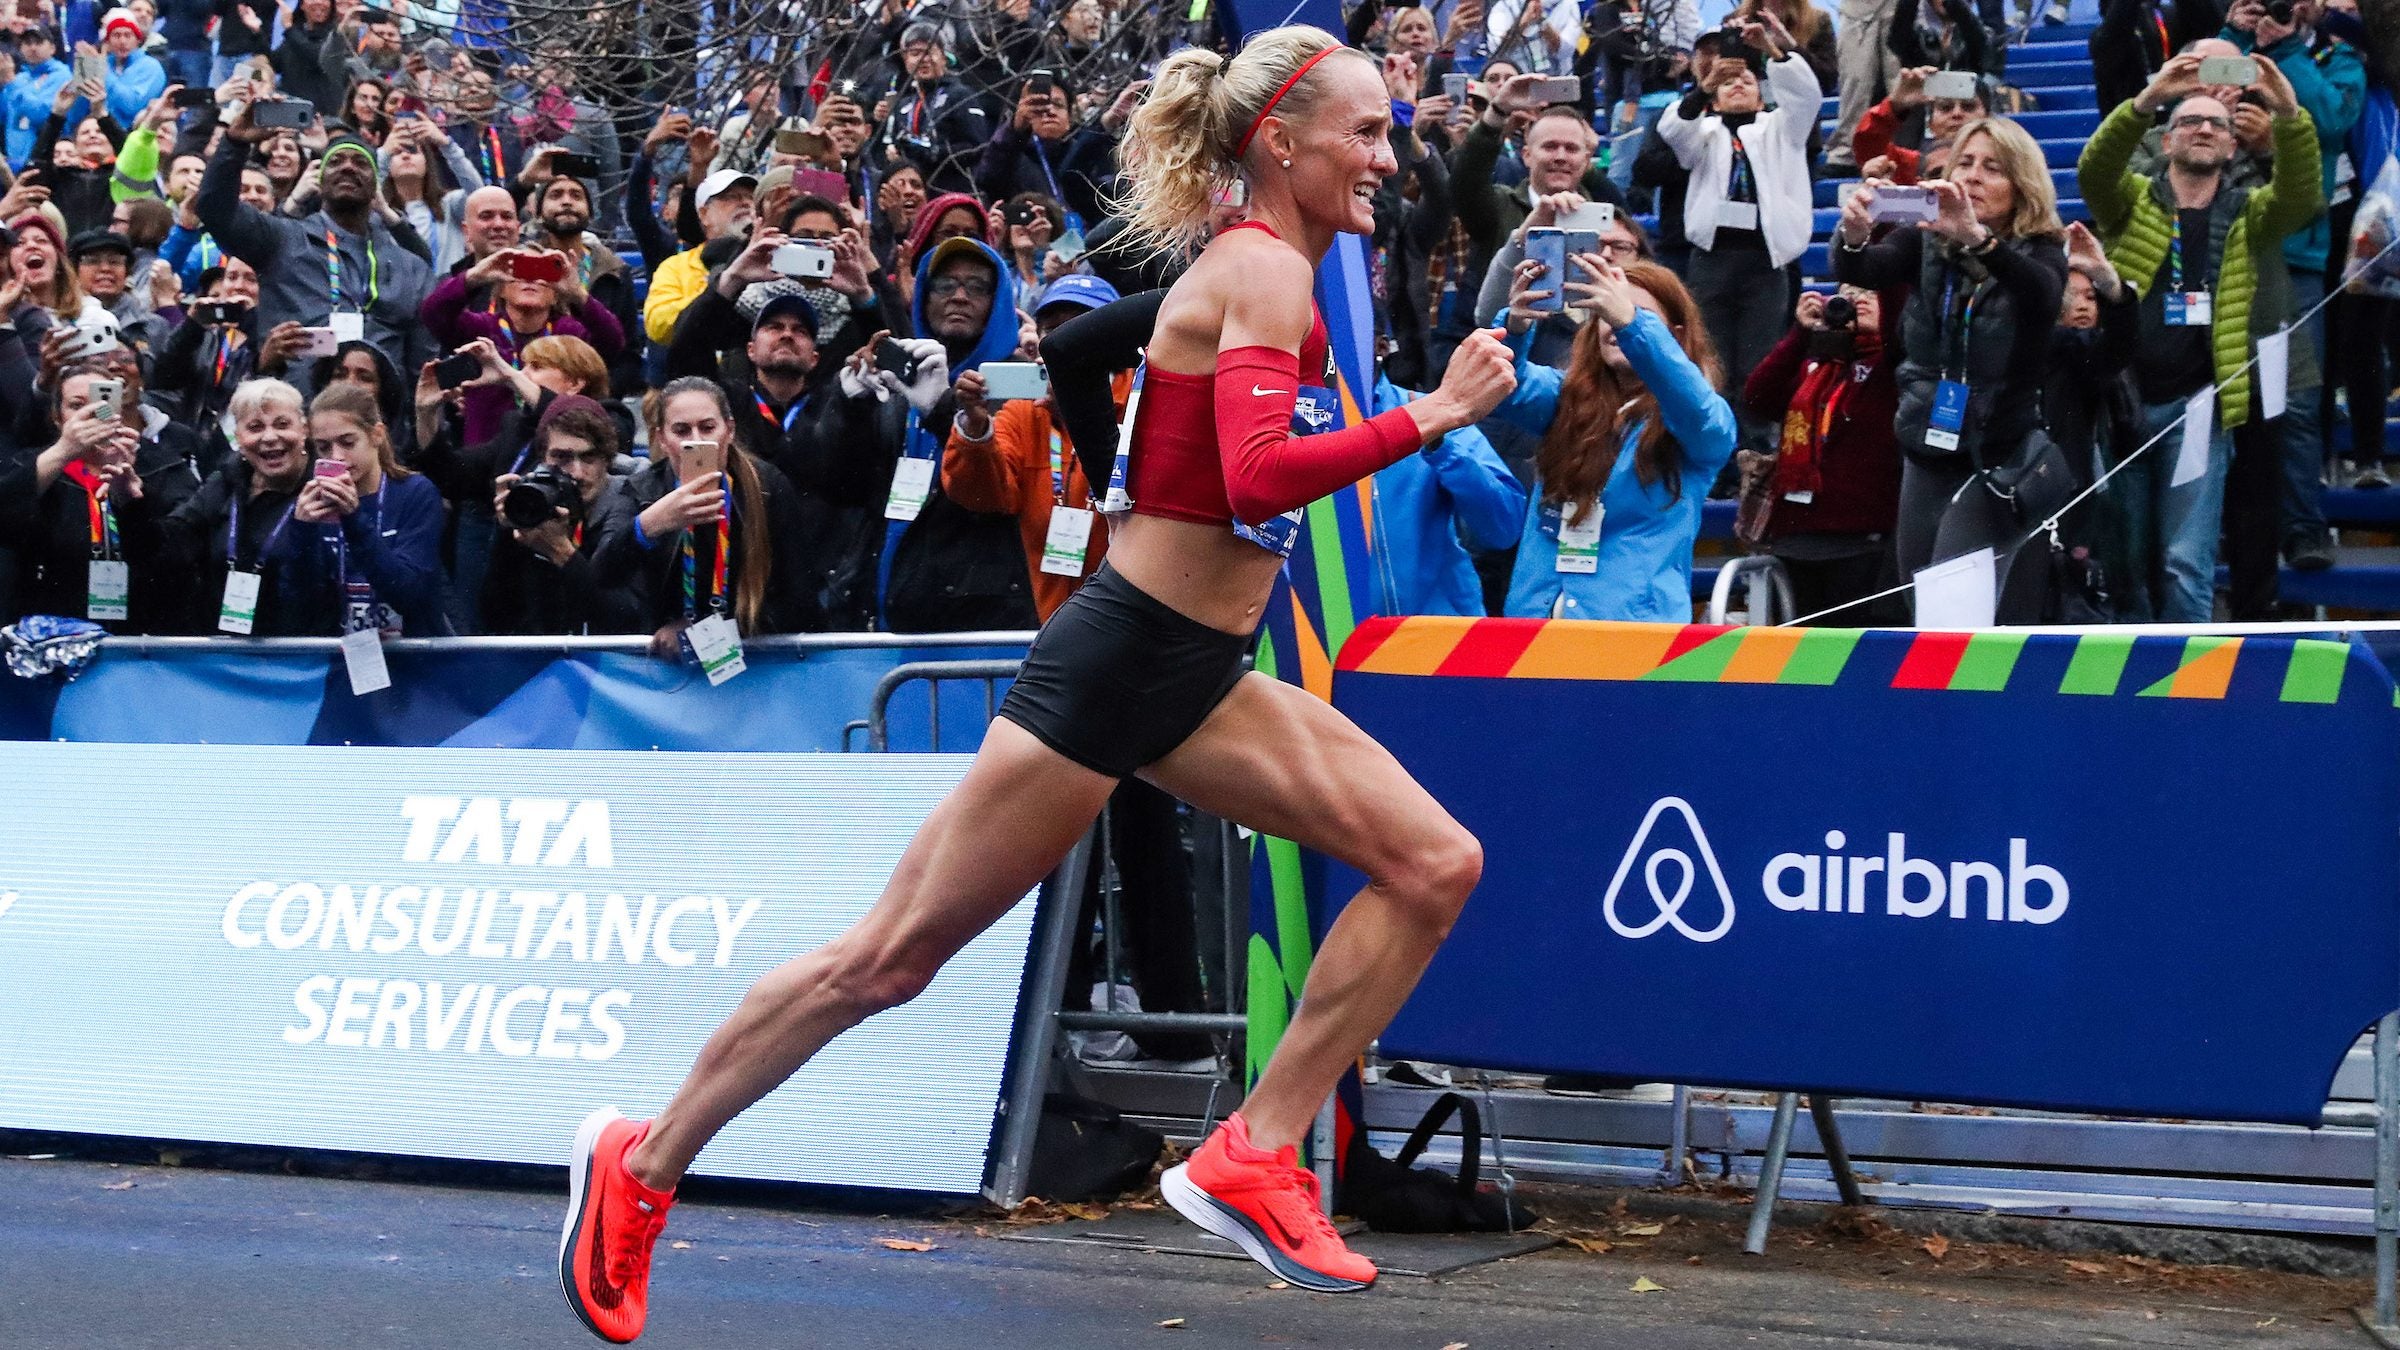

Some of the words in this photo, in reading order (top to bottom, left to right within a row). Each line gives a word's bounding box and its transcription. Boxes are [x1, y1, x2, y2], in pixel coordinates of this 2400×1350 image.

[400, 798, 614, 867] TATA
[1762, 829, 2070, 925] airbnb
[221, 881, 761, 967] CONSULTANCY
[282, 975, 633, 1061] SERVICES
